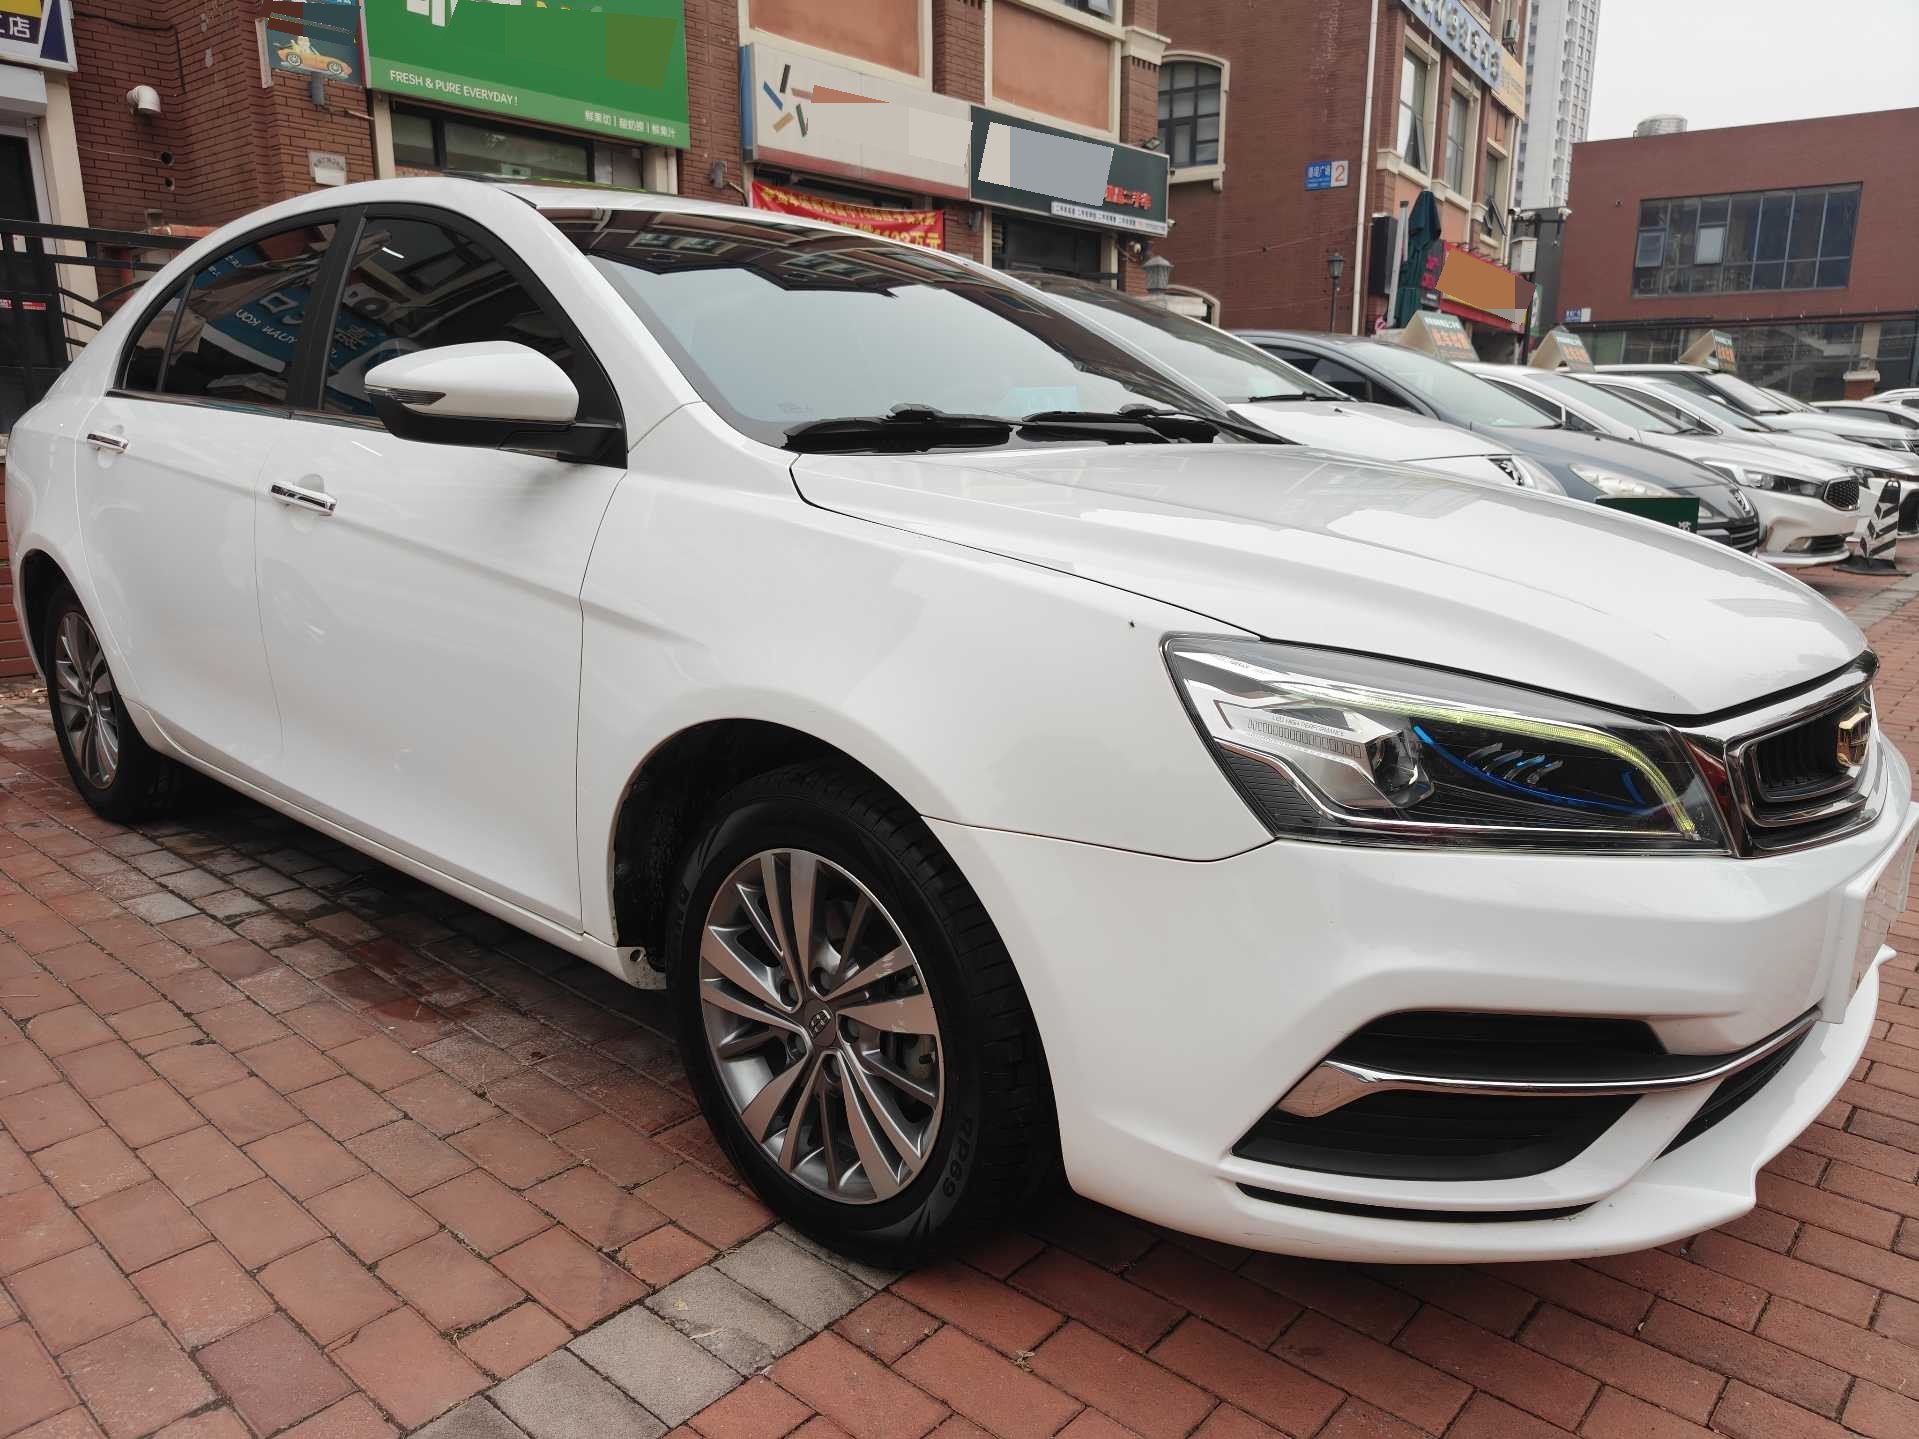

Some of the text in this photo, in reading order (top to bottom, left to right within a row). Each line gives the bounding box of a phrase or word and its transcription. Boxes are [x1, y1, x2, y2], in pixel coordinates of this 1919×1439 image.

[390, 69, 423, 86] FRESH
[425, 78, 434, 88] &
[435, 79, 462, 95] PURE
[1335, 164, 1345, 182] 2
